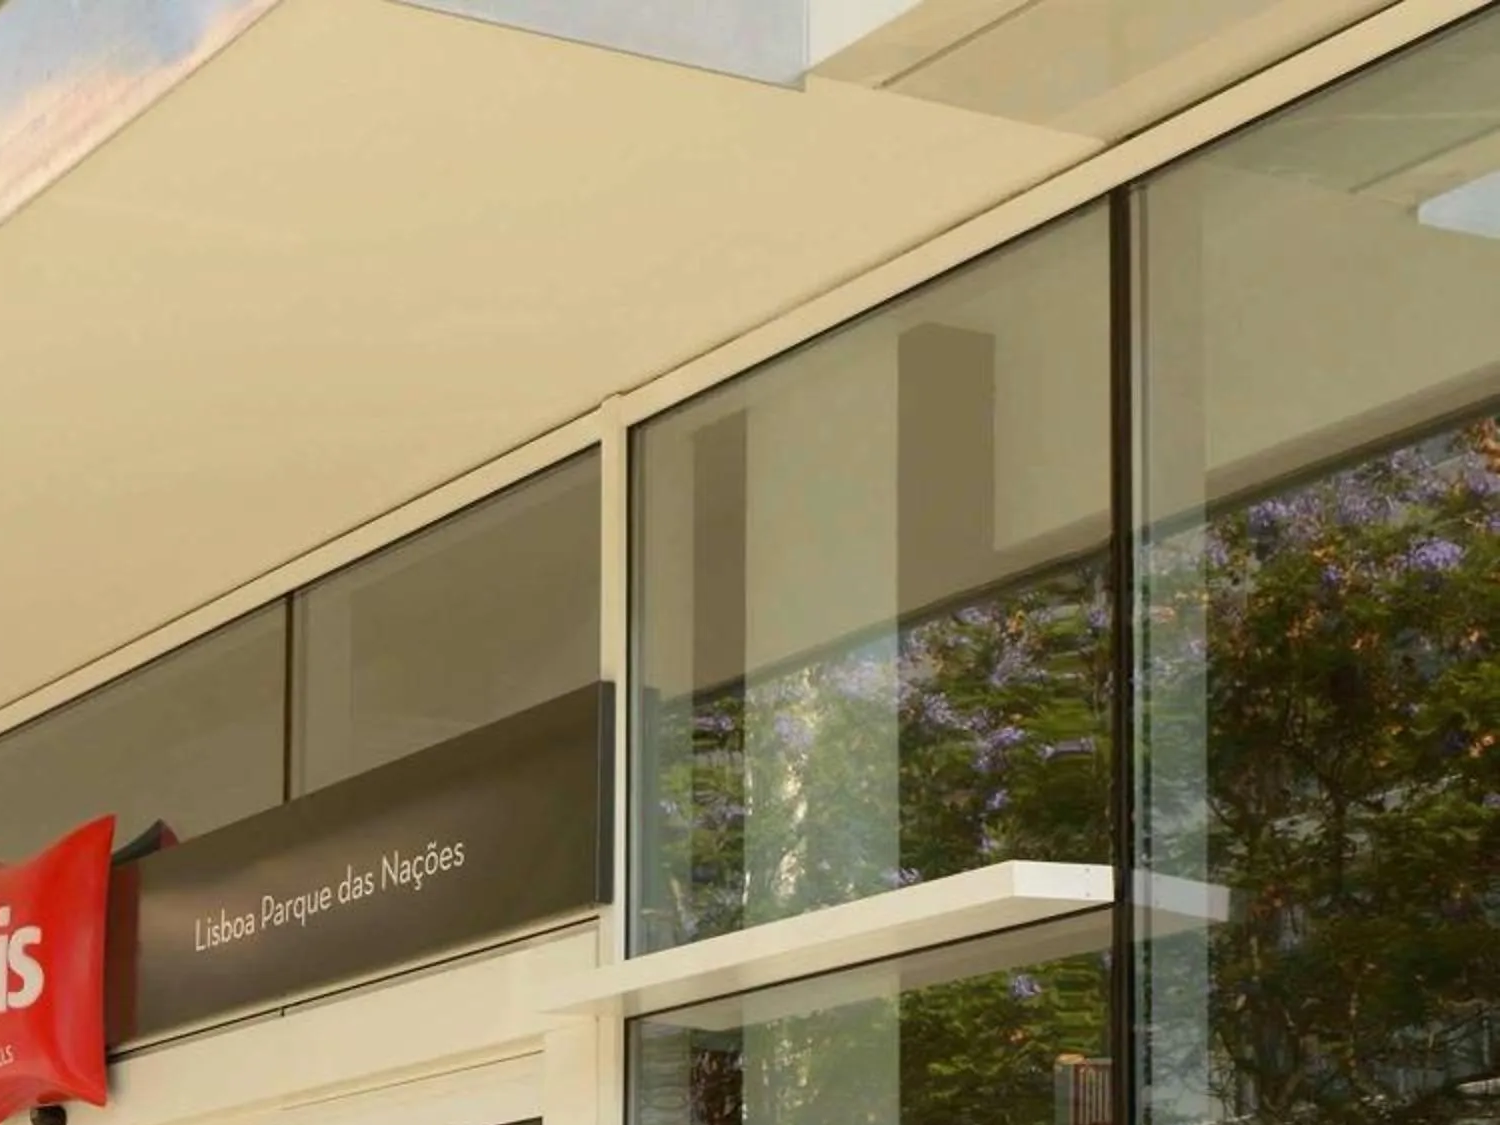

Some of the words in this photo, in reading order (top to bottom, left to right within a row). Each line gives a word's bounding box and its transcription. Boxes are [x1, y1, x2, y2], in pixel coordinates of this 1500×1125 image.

[195, 908, 255, 951] Lisboa
[261, 886, 332, 929] Parque
[338, 864, 374, 904] das
[381, 841, 465, 890] Nações
